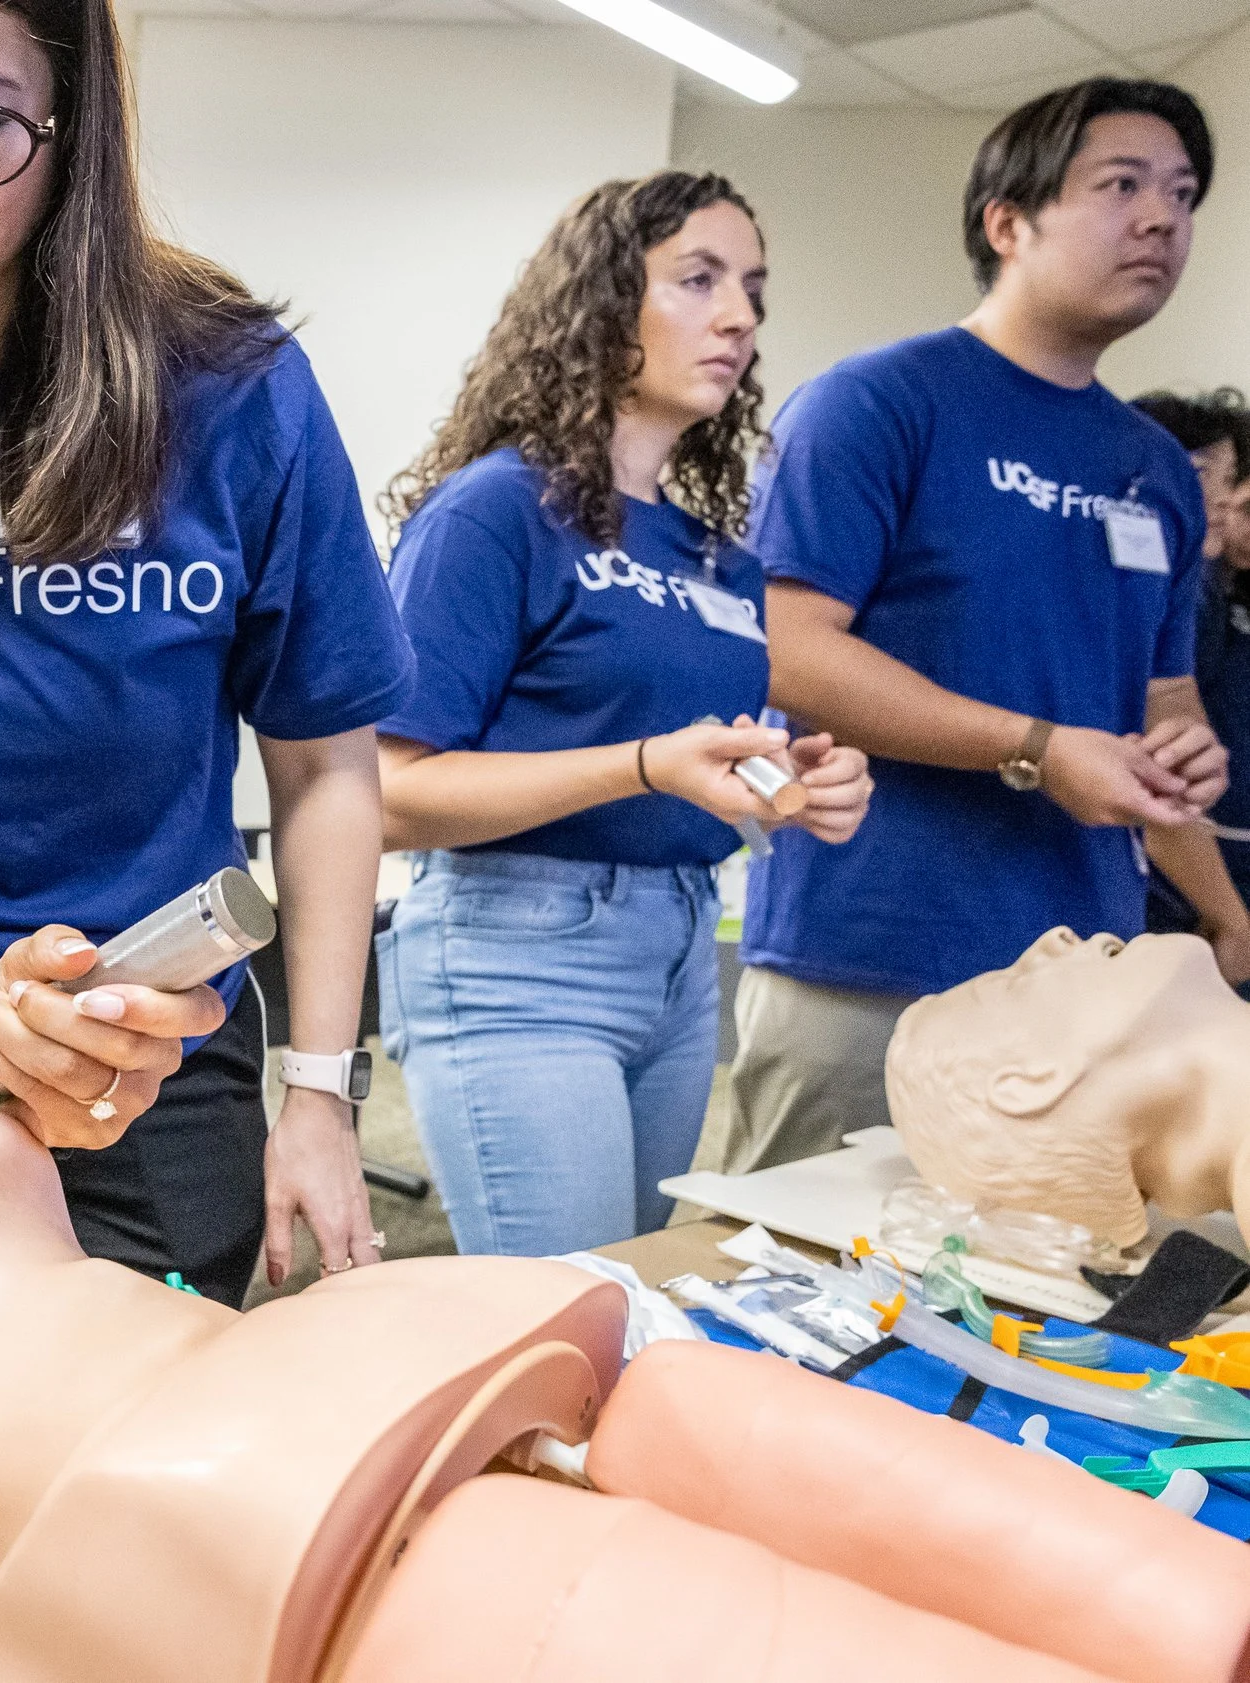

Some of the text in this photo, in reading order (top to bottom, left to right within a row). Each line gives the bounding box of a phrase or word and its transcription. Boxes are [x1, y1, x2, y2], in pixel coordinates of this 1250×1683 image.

[987, 457, 1154, 521] UCSF Fre
[575, 549, 668, 608] UCSF
